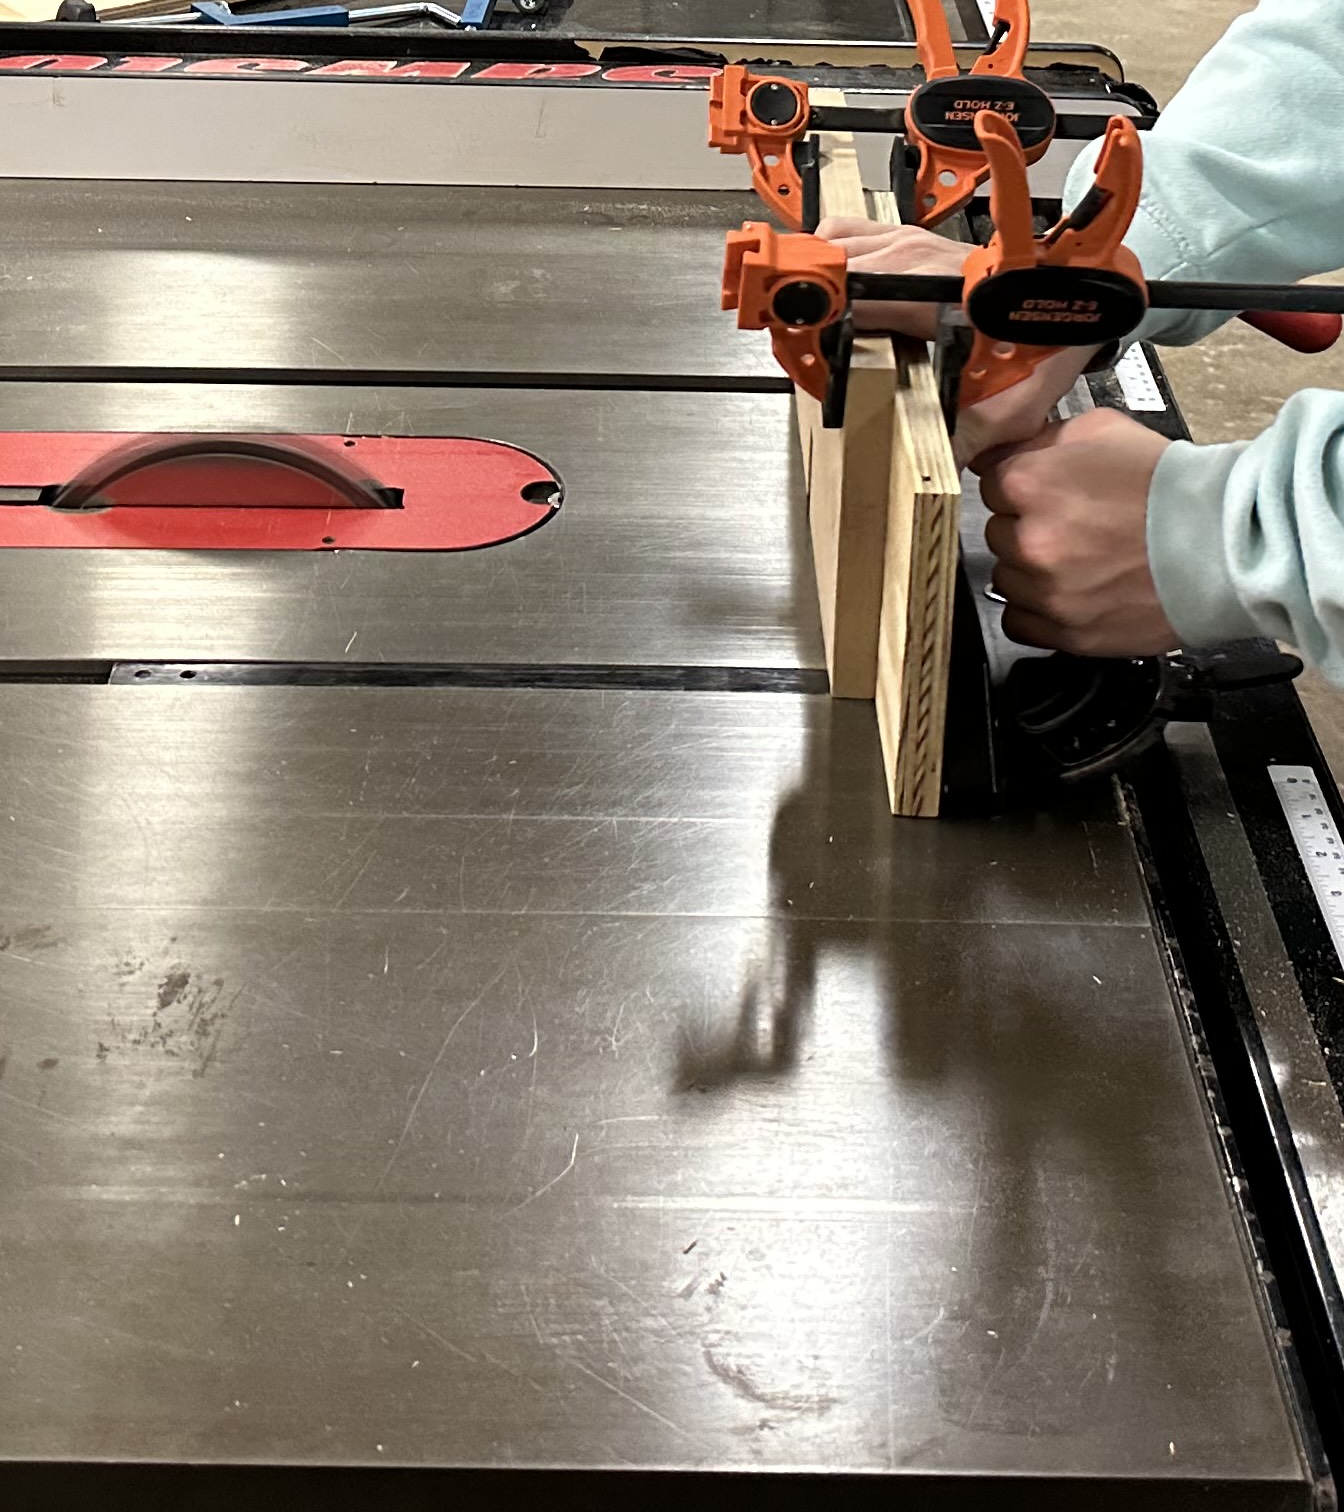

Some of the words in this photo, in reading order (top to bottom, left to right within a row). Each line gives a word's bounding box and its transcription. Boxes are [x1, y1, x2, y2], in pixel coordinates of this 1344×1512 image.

[953, 99, 991, 109] HOLD
[994, 100, 1016, 110] E-Z
[1008, 311, 1103, 322] JORGENSEN
